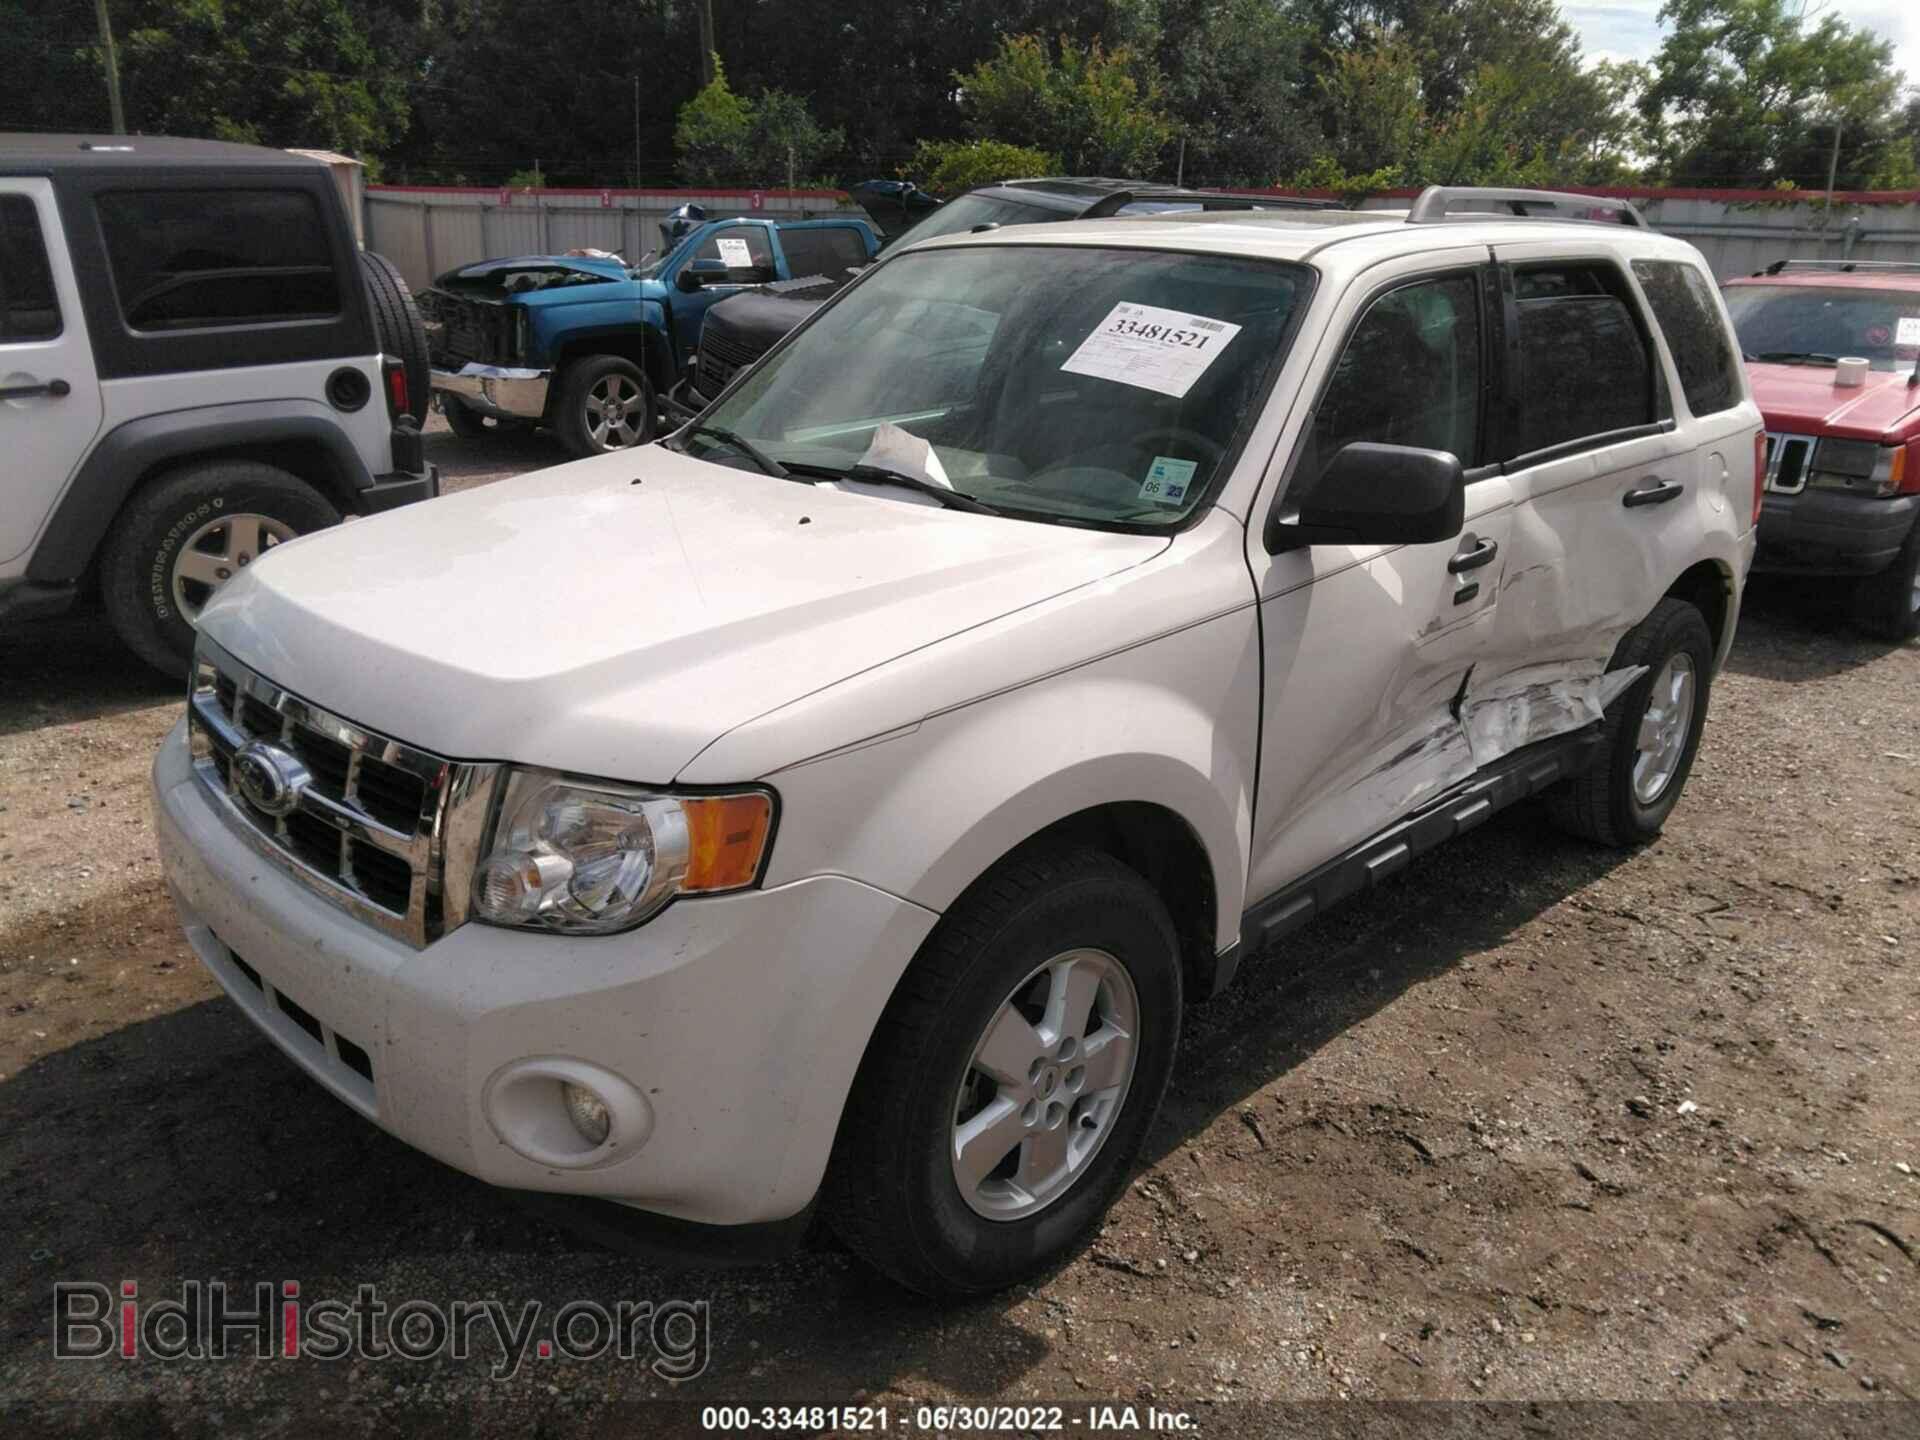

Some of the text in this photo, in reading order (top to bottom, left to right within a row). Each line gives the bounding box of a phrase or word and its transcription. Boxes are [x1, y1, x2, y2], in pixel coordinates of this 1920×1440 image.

[752, 193, 760, 208] 3
[1108, 319, 1211, 349] 33481521
[1145, 481, 1161, 493] 06
